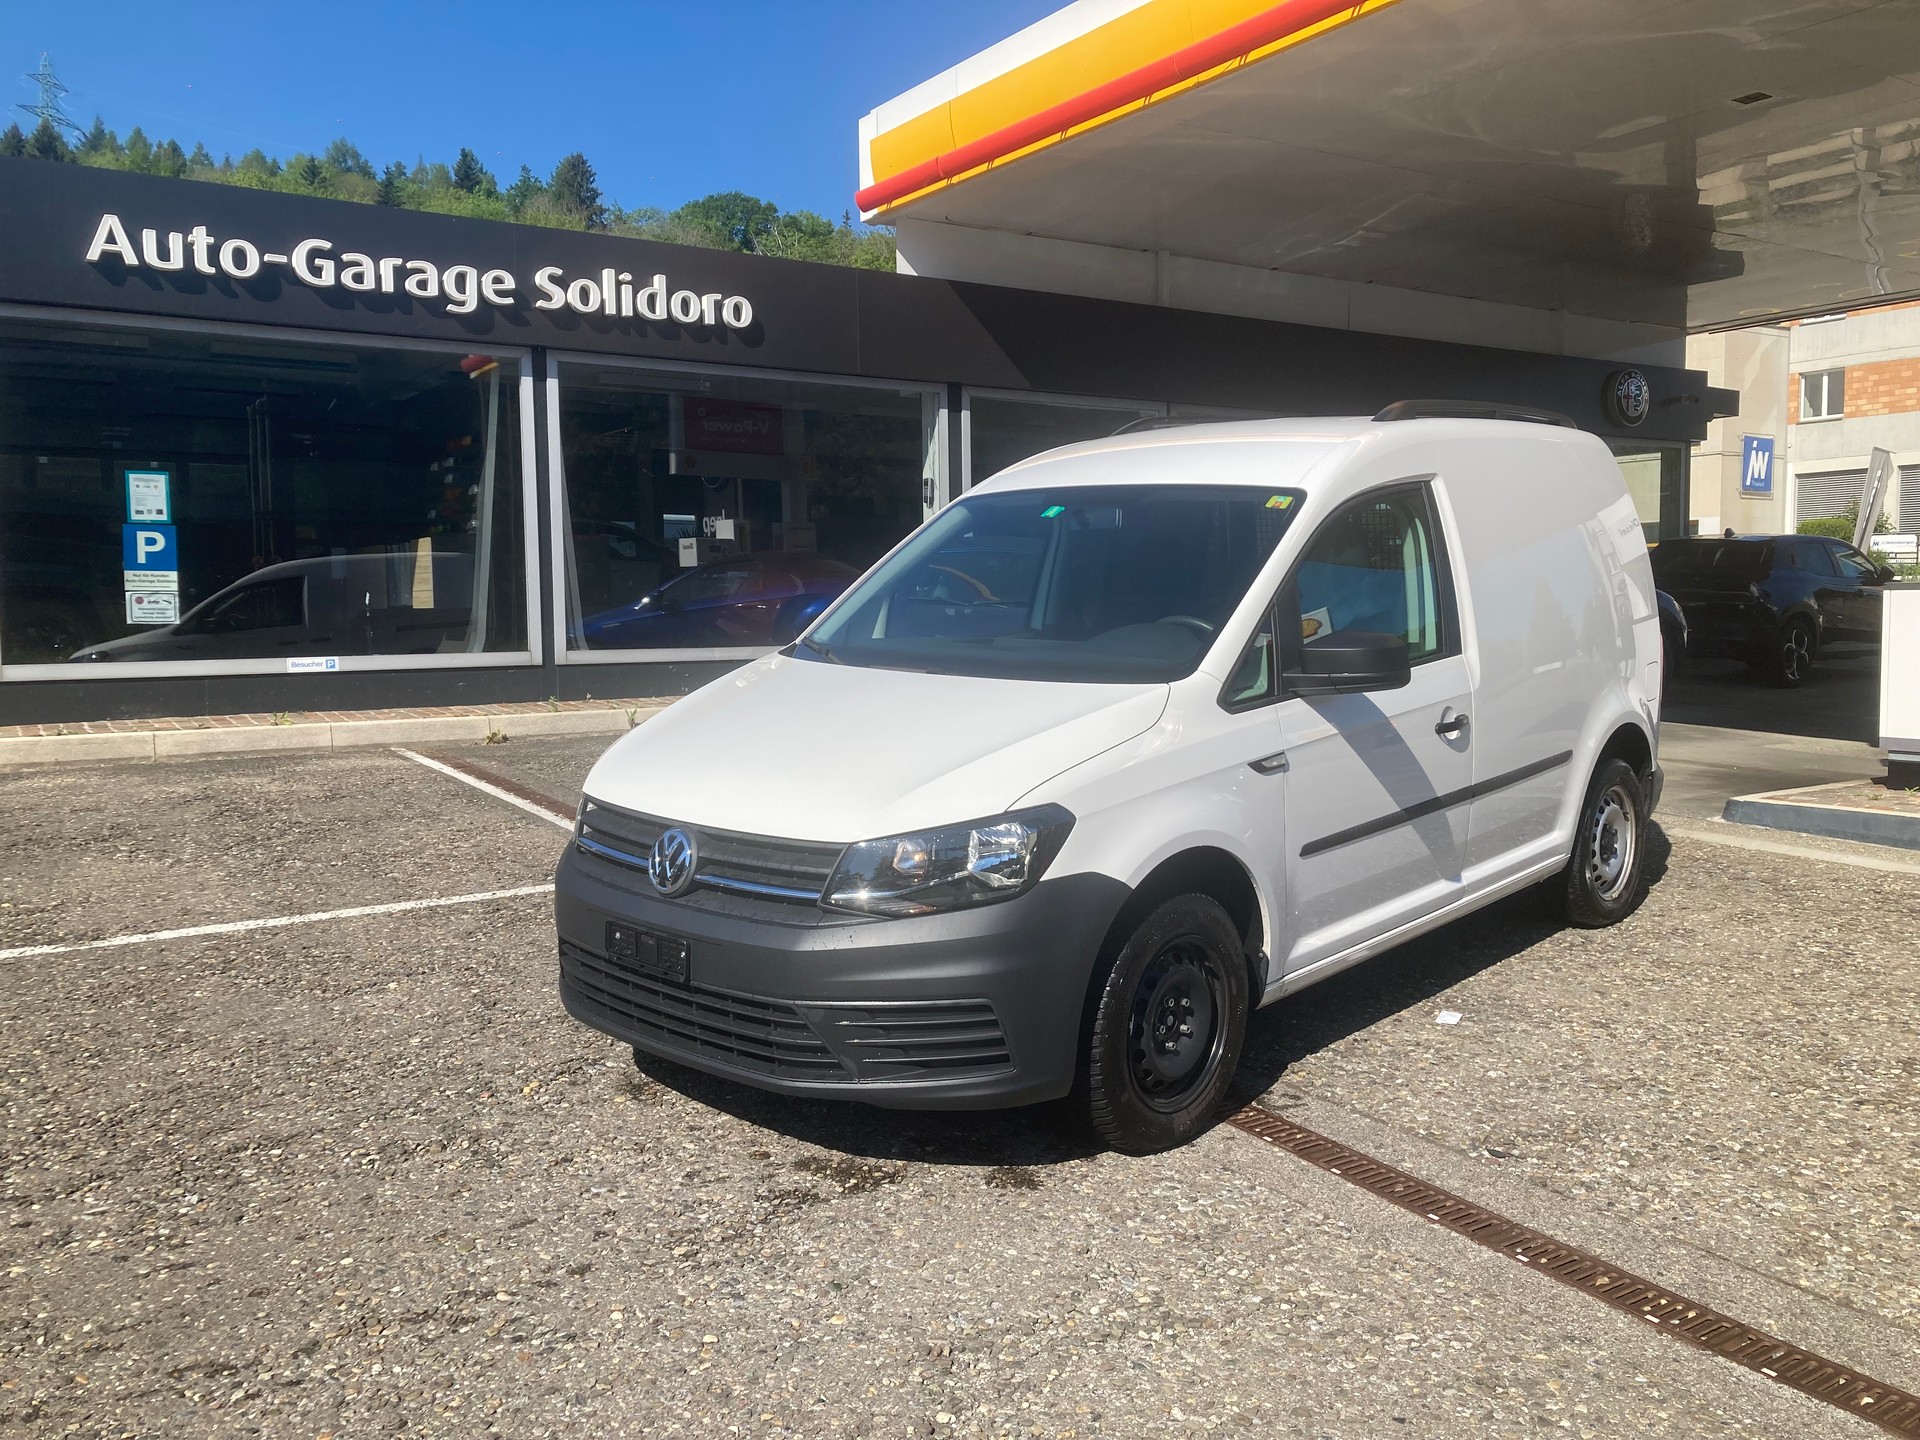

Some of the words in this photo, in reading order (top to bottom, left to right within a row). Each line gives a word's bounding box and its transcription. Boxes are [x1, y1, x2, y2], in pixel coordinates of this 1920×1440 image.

[85, 213, 516, 315] Auto-Garage
[534, 265, 754, 330] Solidoro
[136, 530, 166, 564] P
[327, 660, 335, 668] P
